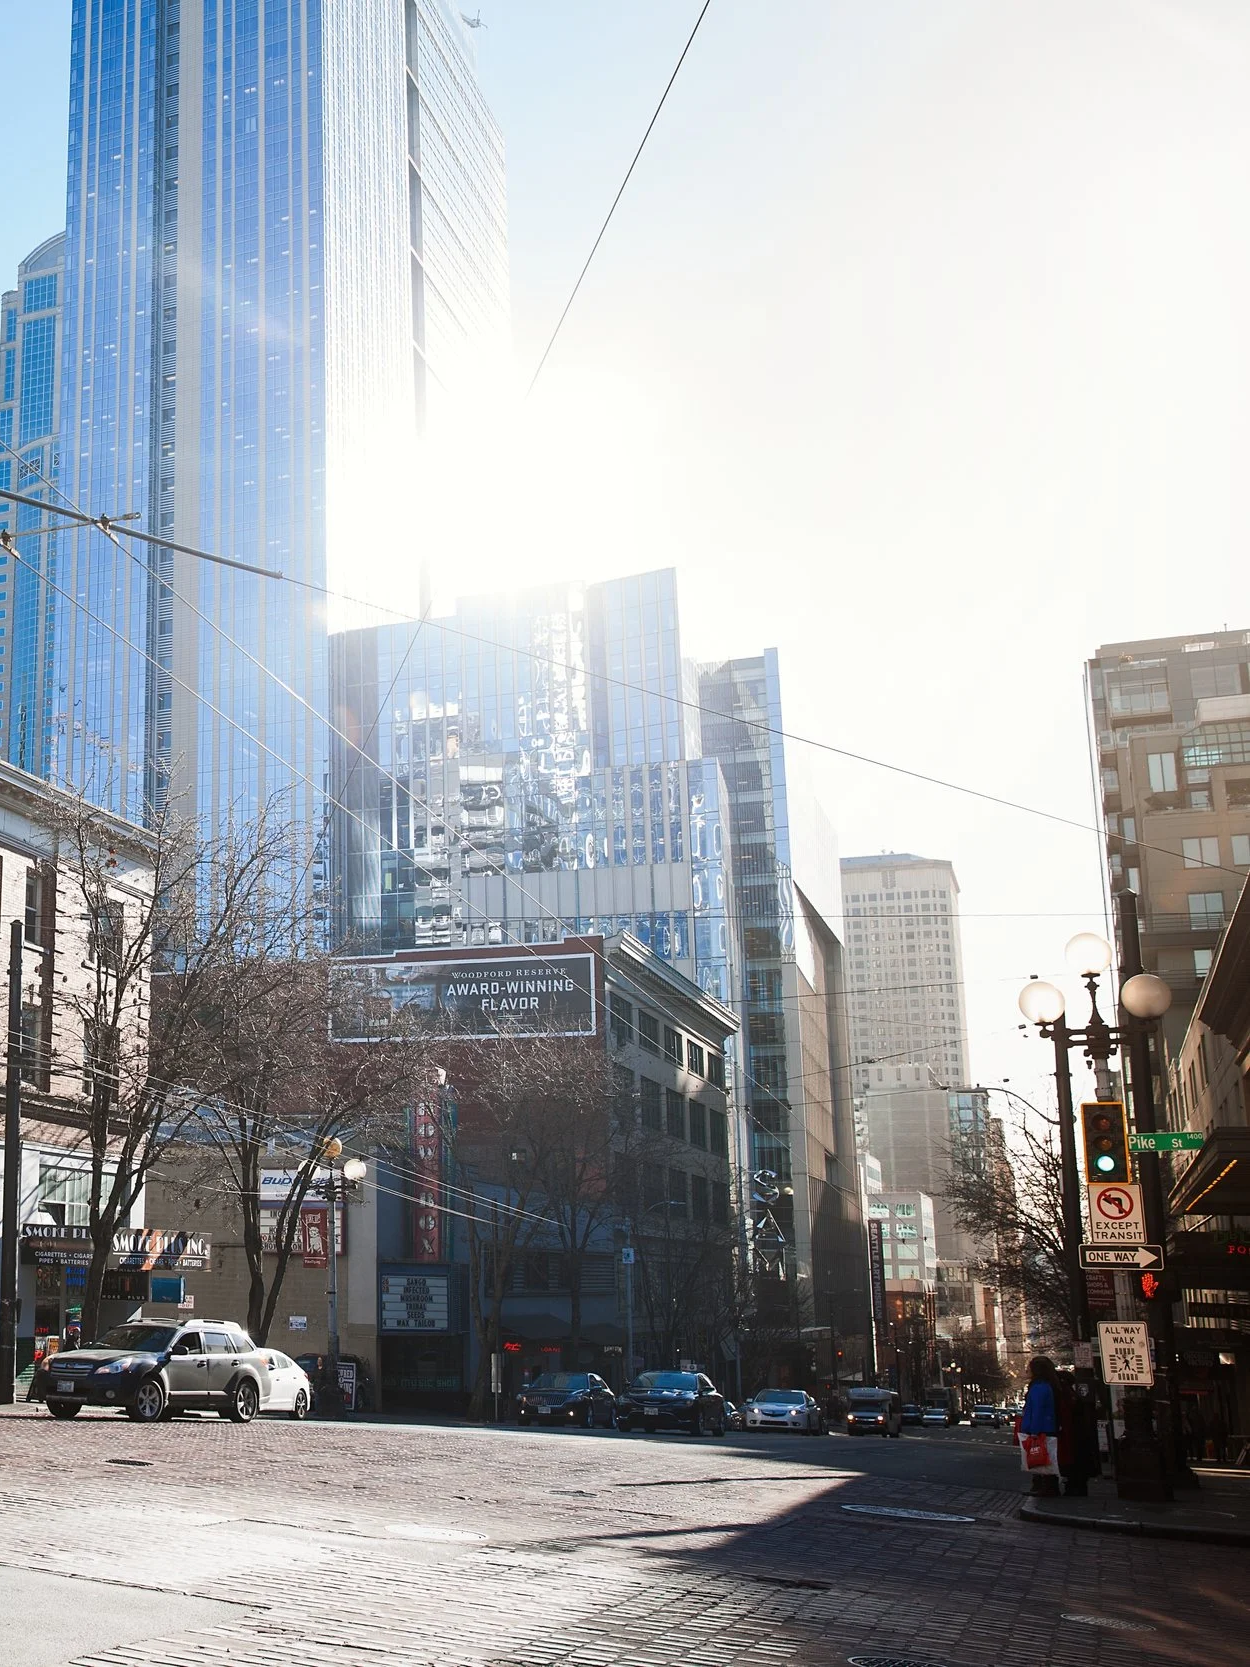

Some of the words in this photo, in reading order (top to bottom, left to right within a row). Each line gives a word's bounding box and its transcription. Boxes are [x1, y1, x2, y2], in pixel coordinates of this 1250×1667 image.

[451, 970, 511, 979] WOODFORD
[515, 967, 568, 977] RESERVE
[446, 979, 574, 997] AWARD-WINNING
[481, 997, 540, 1012] FLAVOR
[1128, 1136, 1156, 1150] Pike
[1171, 1138, 1183, 1148] St
[1096, 1221, 1140, 1230] EXCEPT
[25, 1225, 69, 1239] SMOKE
[1094, 1231, 1143, 1240] TRANSIT
[112, 1232, 153, 1253] SMOKE
[156, 1235, 184, 1255] PLUS
[870, 1222, 880, 1260] SEATTLE
[119, 1256, 144, 1265] CIGARETTES
[182, 1259, 202, 1267] BATTERIES
[1088, 1252, 1111, 1262] ONE
[1113, 1252, 1137, 1262] WAY
[872, 1261, 881, 1280] ART
[403, 1287, 430, 1295] INFECTED
[400, 1295, 433, 1303] MUSHROOM
[873, 1281, 883, 1320] MUSEUM
[406, 1311, 425, 1319] SEEDS
[1104, 1327, 1121, 1335] ALL
[1122, 1327, 1141, 1335] WAY
[1112, 1336, 1135, 1344] WALK
